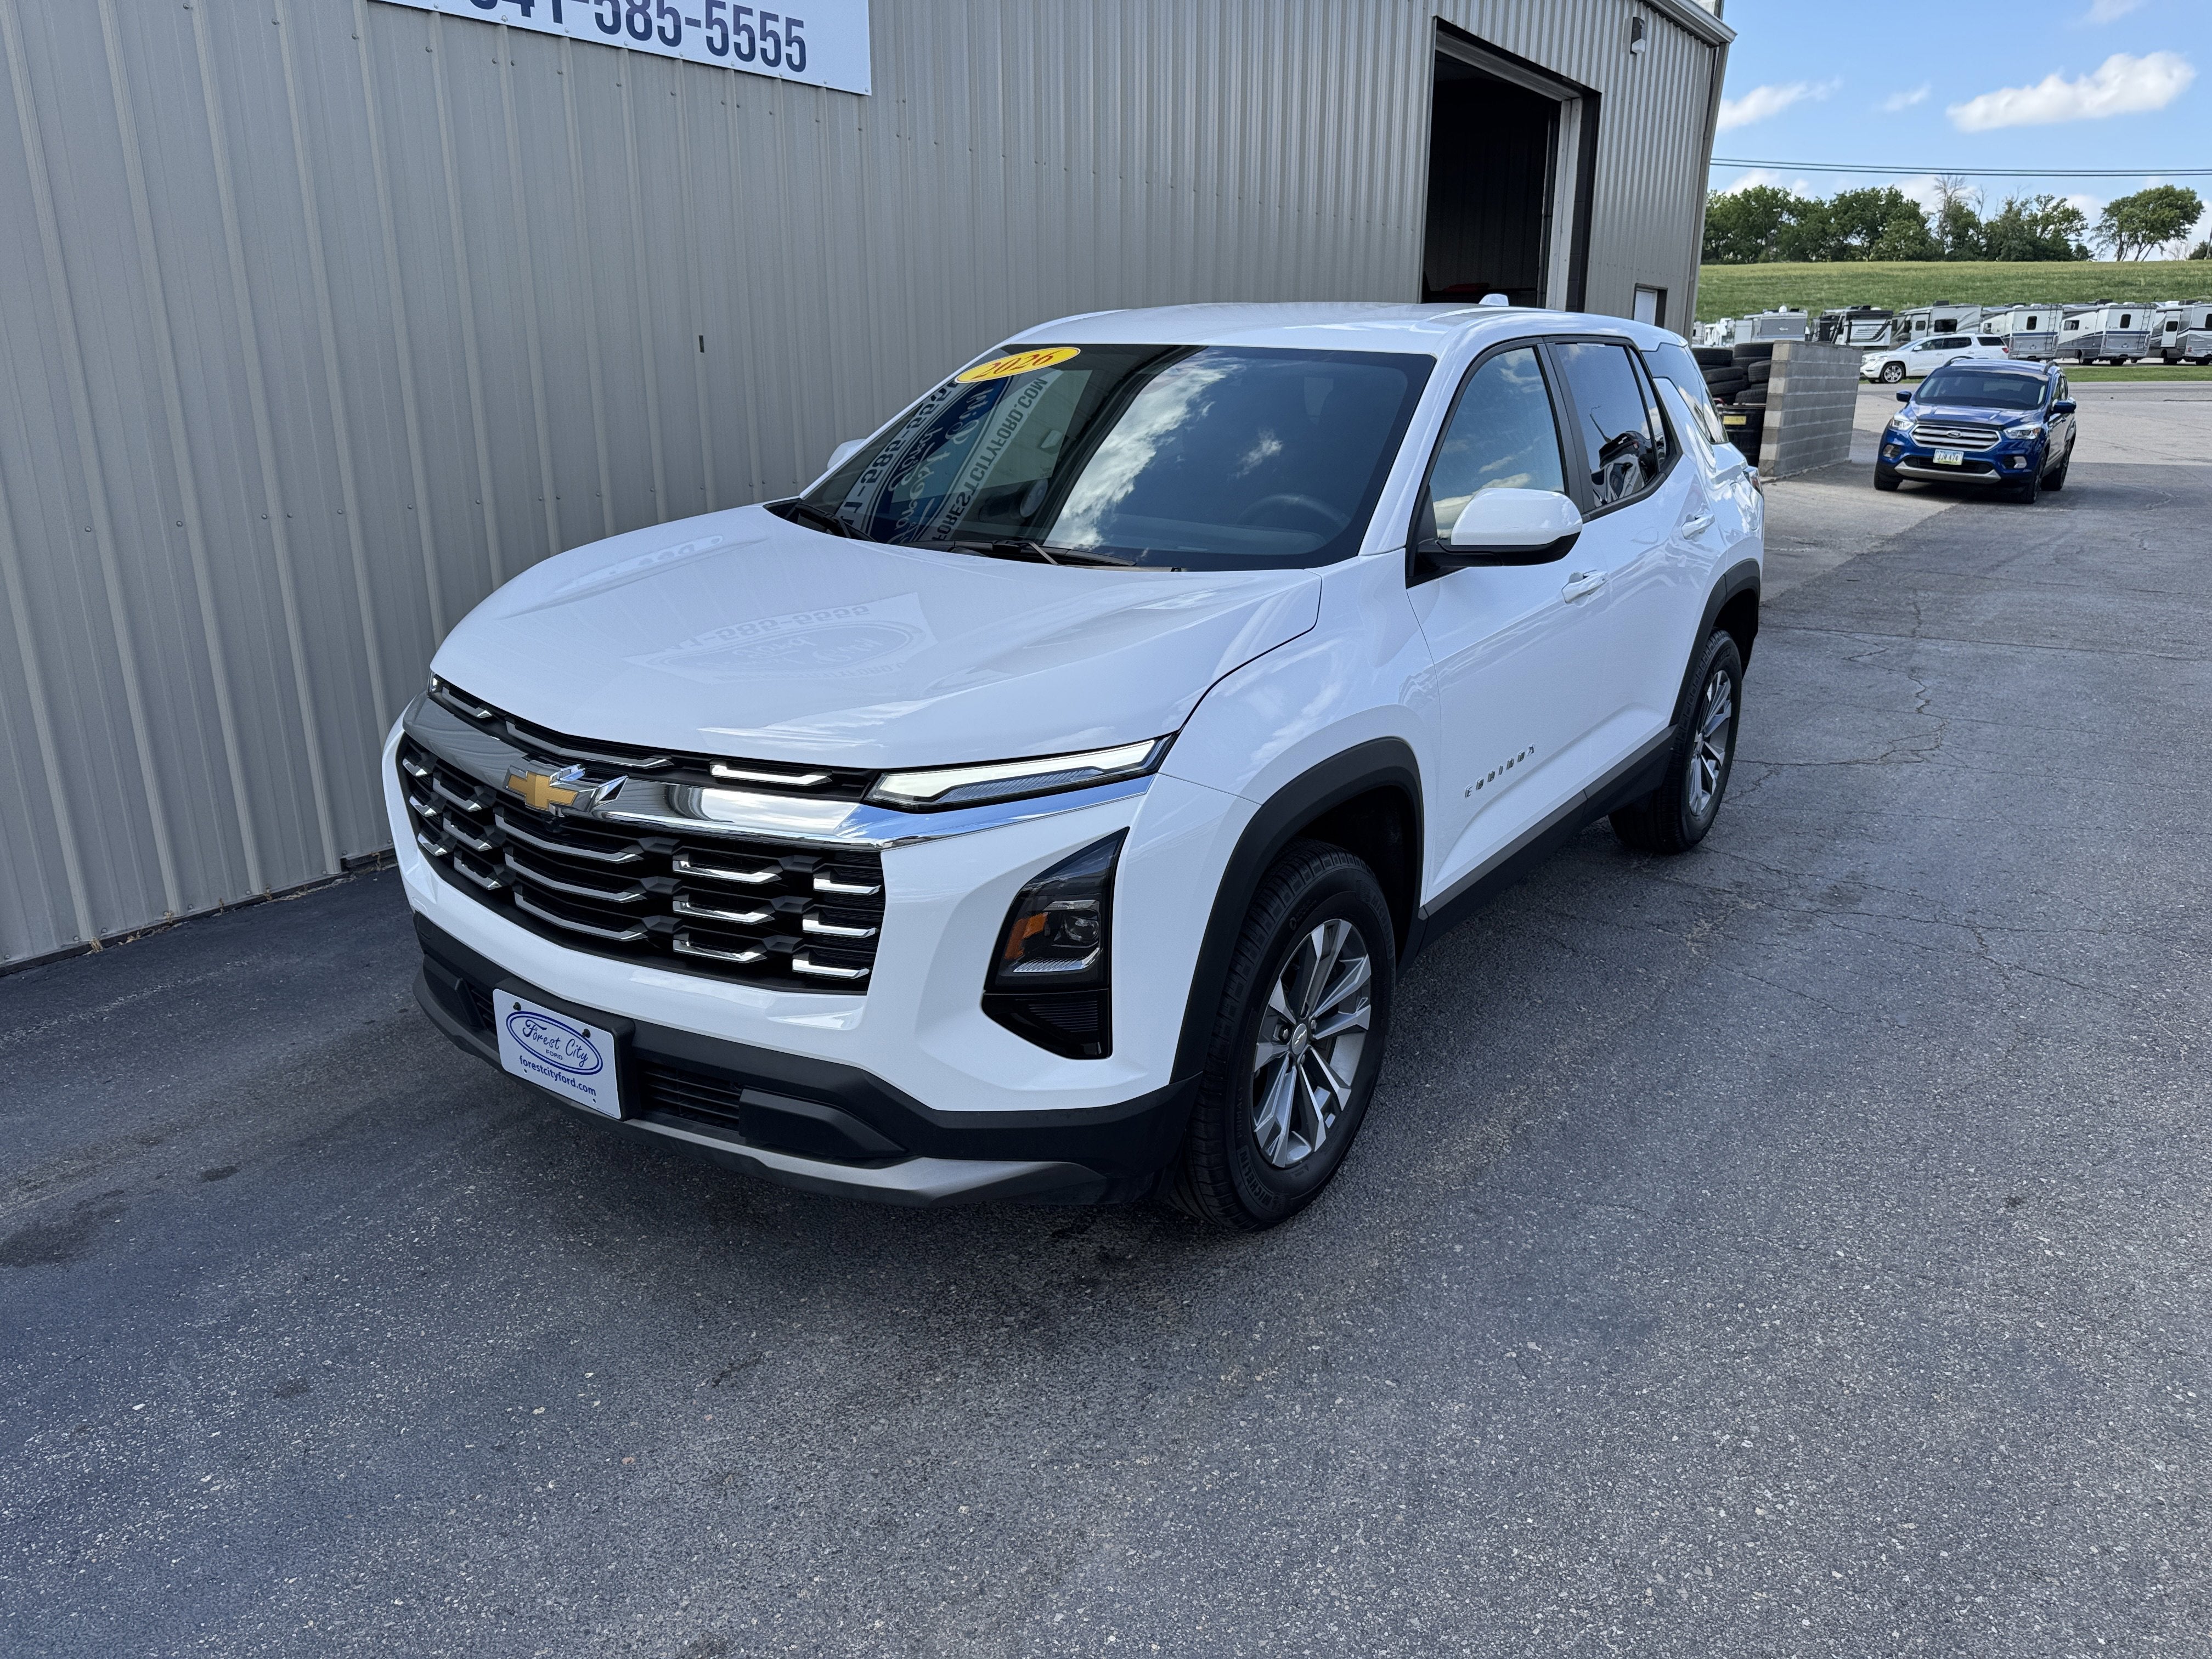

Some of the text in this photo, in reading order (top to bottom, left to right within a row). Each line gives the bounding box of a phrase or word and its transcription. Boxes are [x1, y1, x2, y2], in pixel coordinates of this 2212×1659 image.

[469, 0, 806, 72] -585-5555
[970, 349, 1064, 379] 2026
[522, 1019, 588, 1067] Forest City
[545, 1049, 563, 1060] FORD
[519, 1055, 596, 1096] forestcityford.com
[1239, 1150, 1273, 1206] MICHELIN
